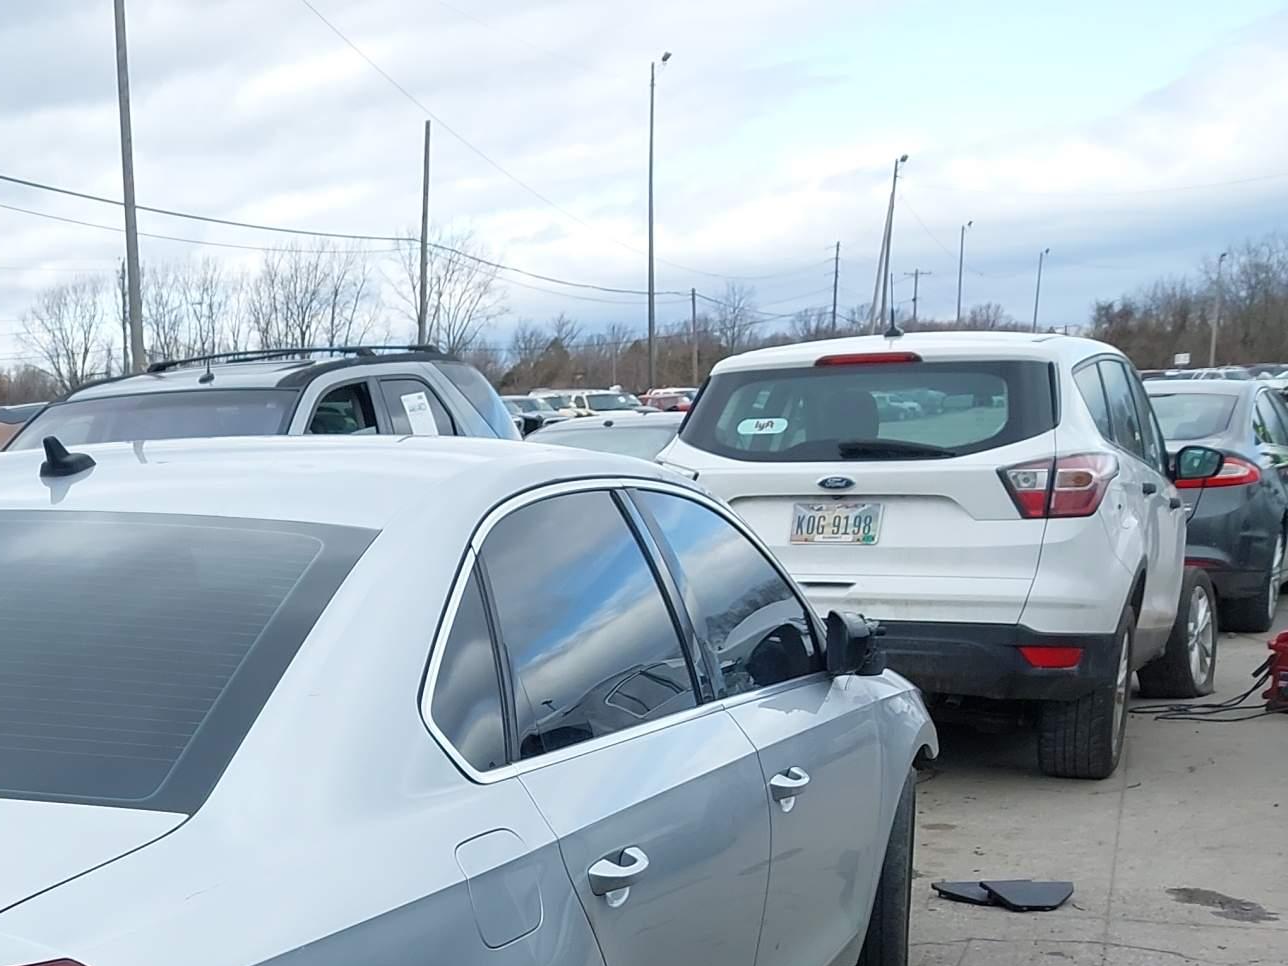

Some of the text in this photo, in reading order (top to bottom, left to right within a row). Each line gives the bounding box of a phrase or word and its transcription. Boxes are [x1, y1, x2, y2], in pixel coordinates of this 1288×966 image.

[754, 420, 775, 431] lyft
[795, 515, 873, 535] KOG 9198
